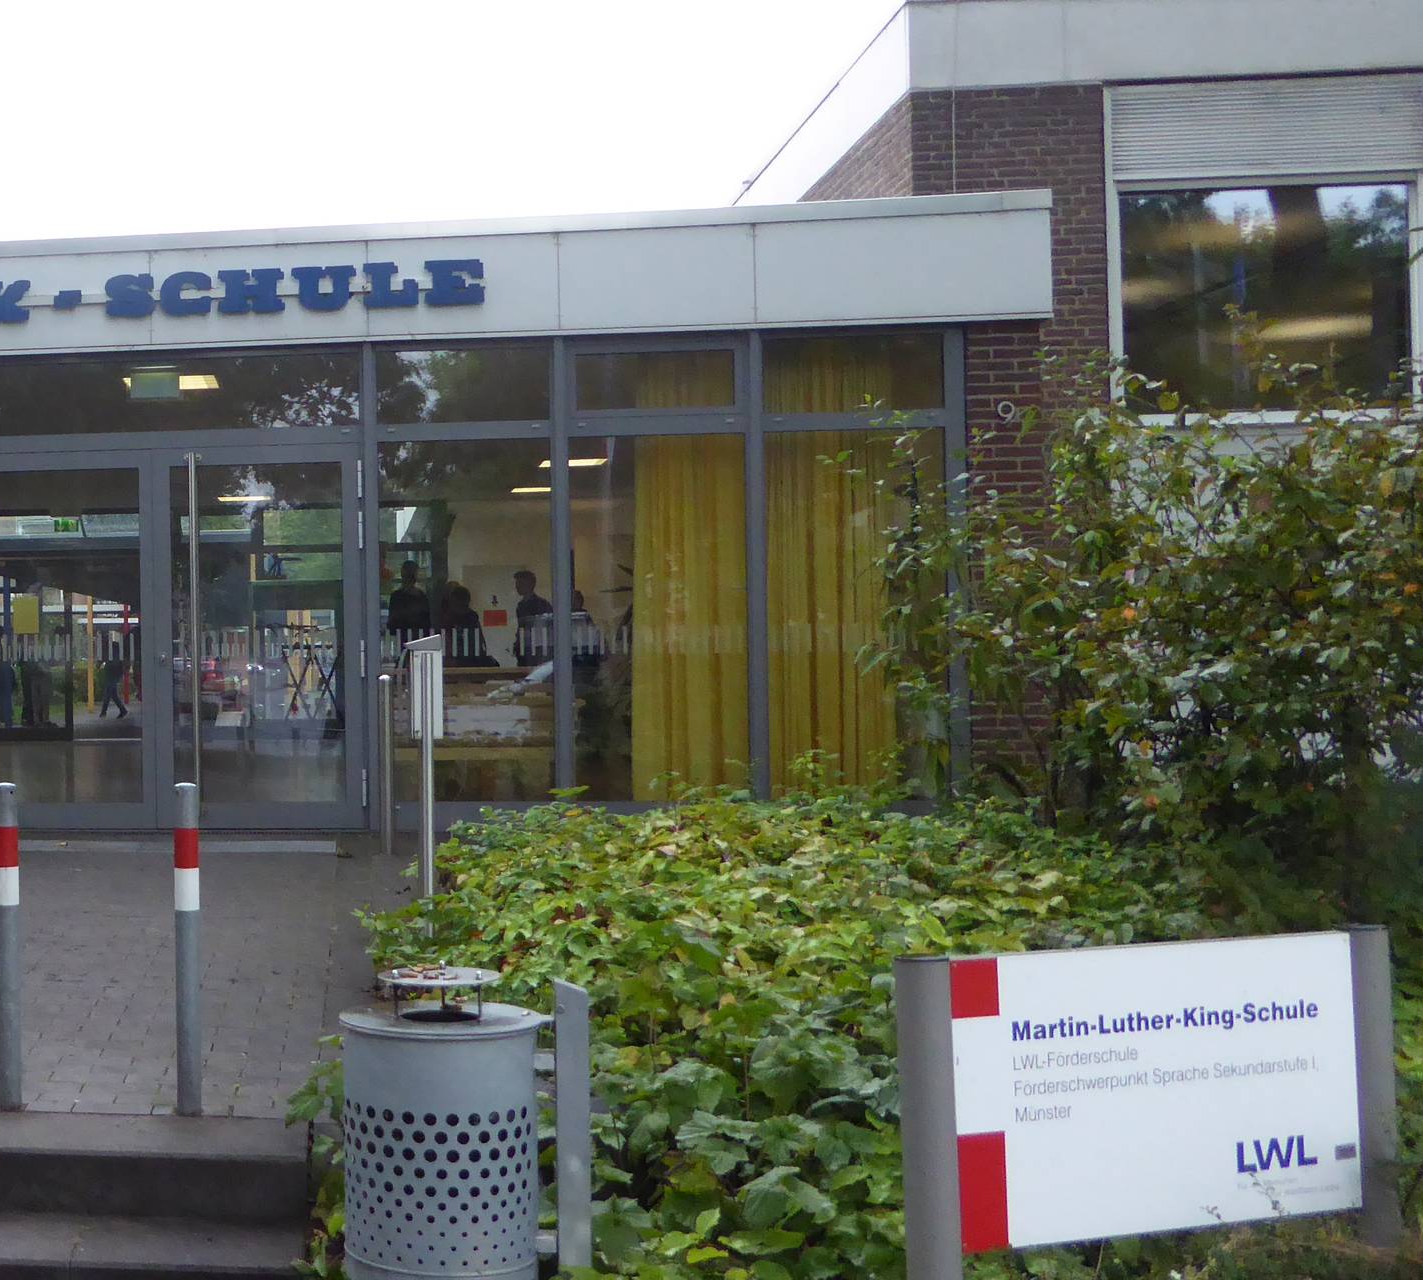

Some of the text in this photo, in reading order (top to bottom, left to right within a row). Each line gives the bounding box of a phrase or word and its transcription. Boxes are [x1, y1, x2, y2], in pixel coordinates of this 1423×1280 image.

[104, 258, 485, 319] SCHULE
[1011, 998, 1319, 1042] Martin-Luther-King-Schule
[1012, 1046, 1139, 1072] LWL-Förderschule
[1013, 1071, 1149, 1097] Förderschwerpunkt
[1152, 1066, 1210, 1087] Sprache
[1213, 1056, 1309, 1080] Sekundarstufe
[1015, 1104, 1072, 1124] Münster
[1236, 1134, 1319, 1174] LWL
